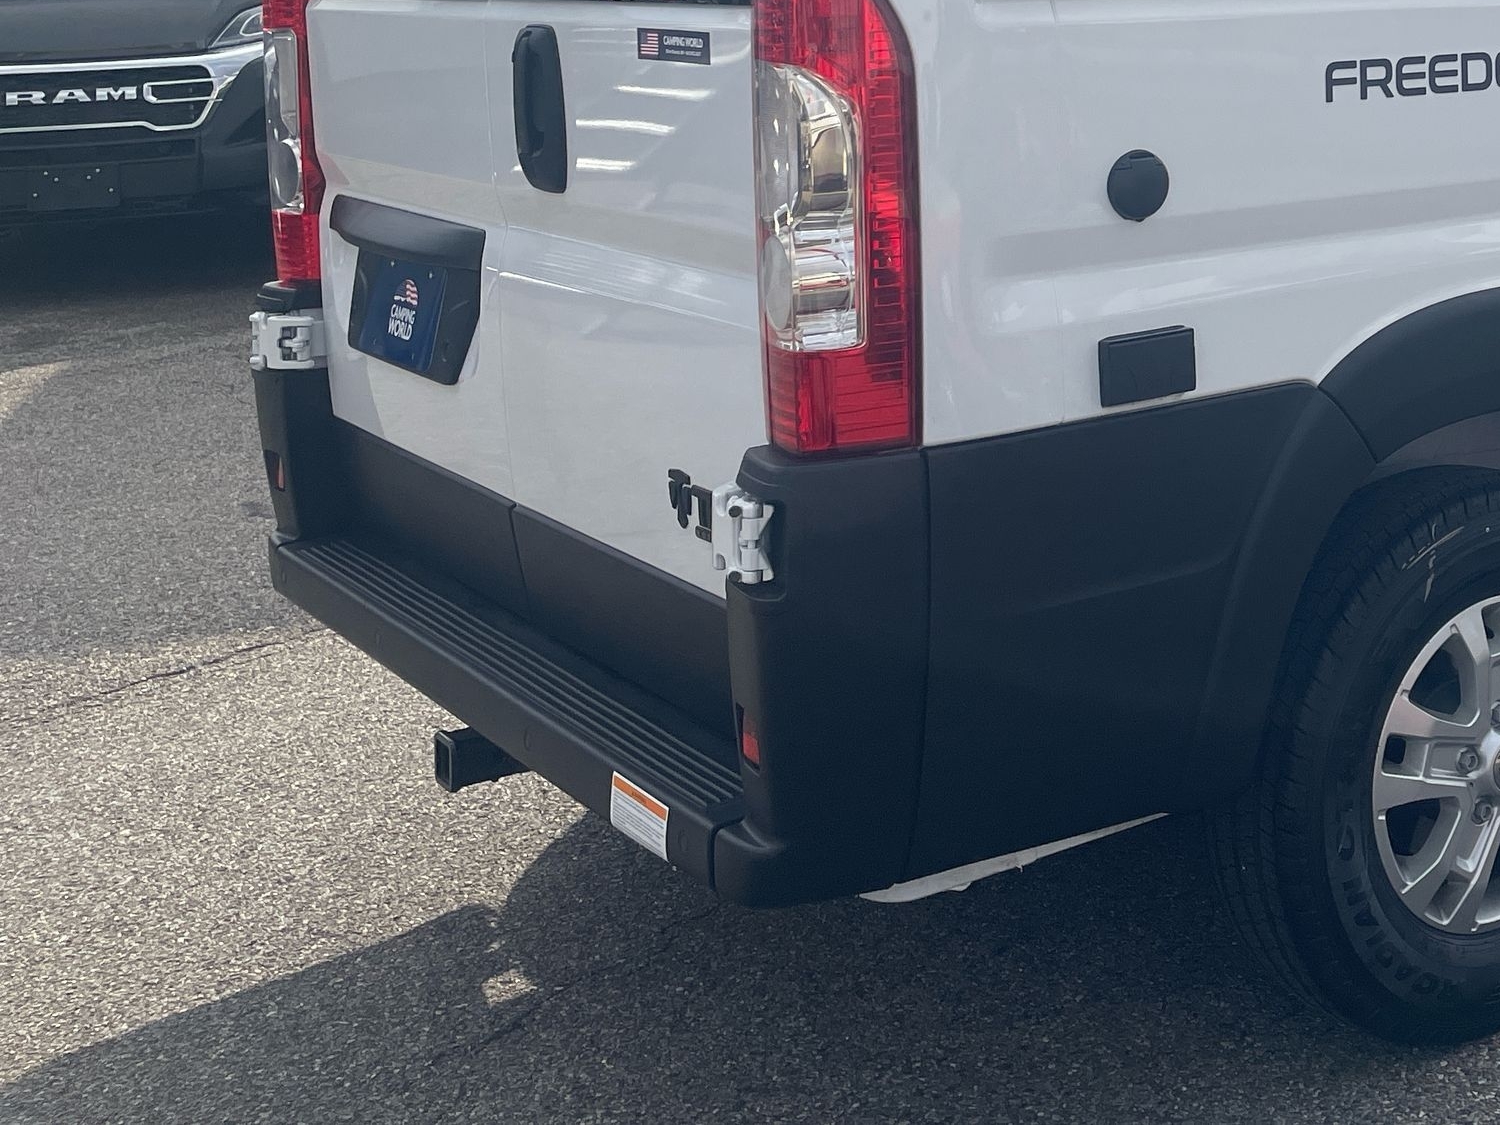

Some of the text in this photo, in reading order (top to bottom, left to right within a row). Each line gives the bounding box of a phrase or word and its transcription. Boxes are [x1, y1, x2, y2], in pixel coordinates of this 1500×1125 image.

[5, 85, 138, 106] RAM
[391, 303, 416, 325] CAMPING
[388, 317, 413, 341] WORLD
